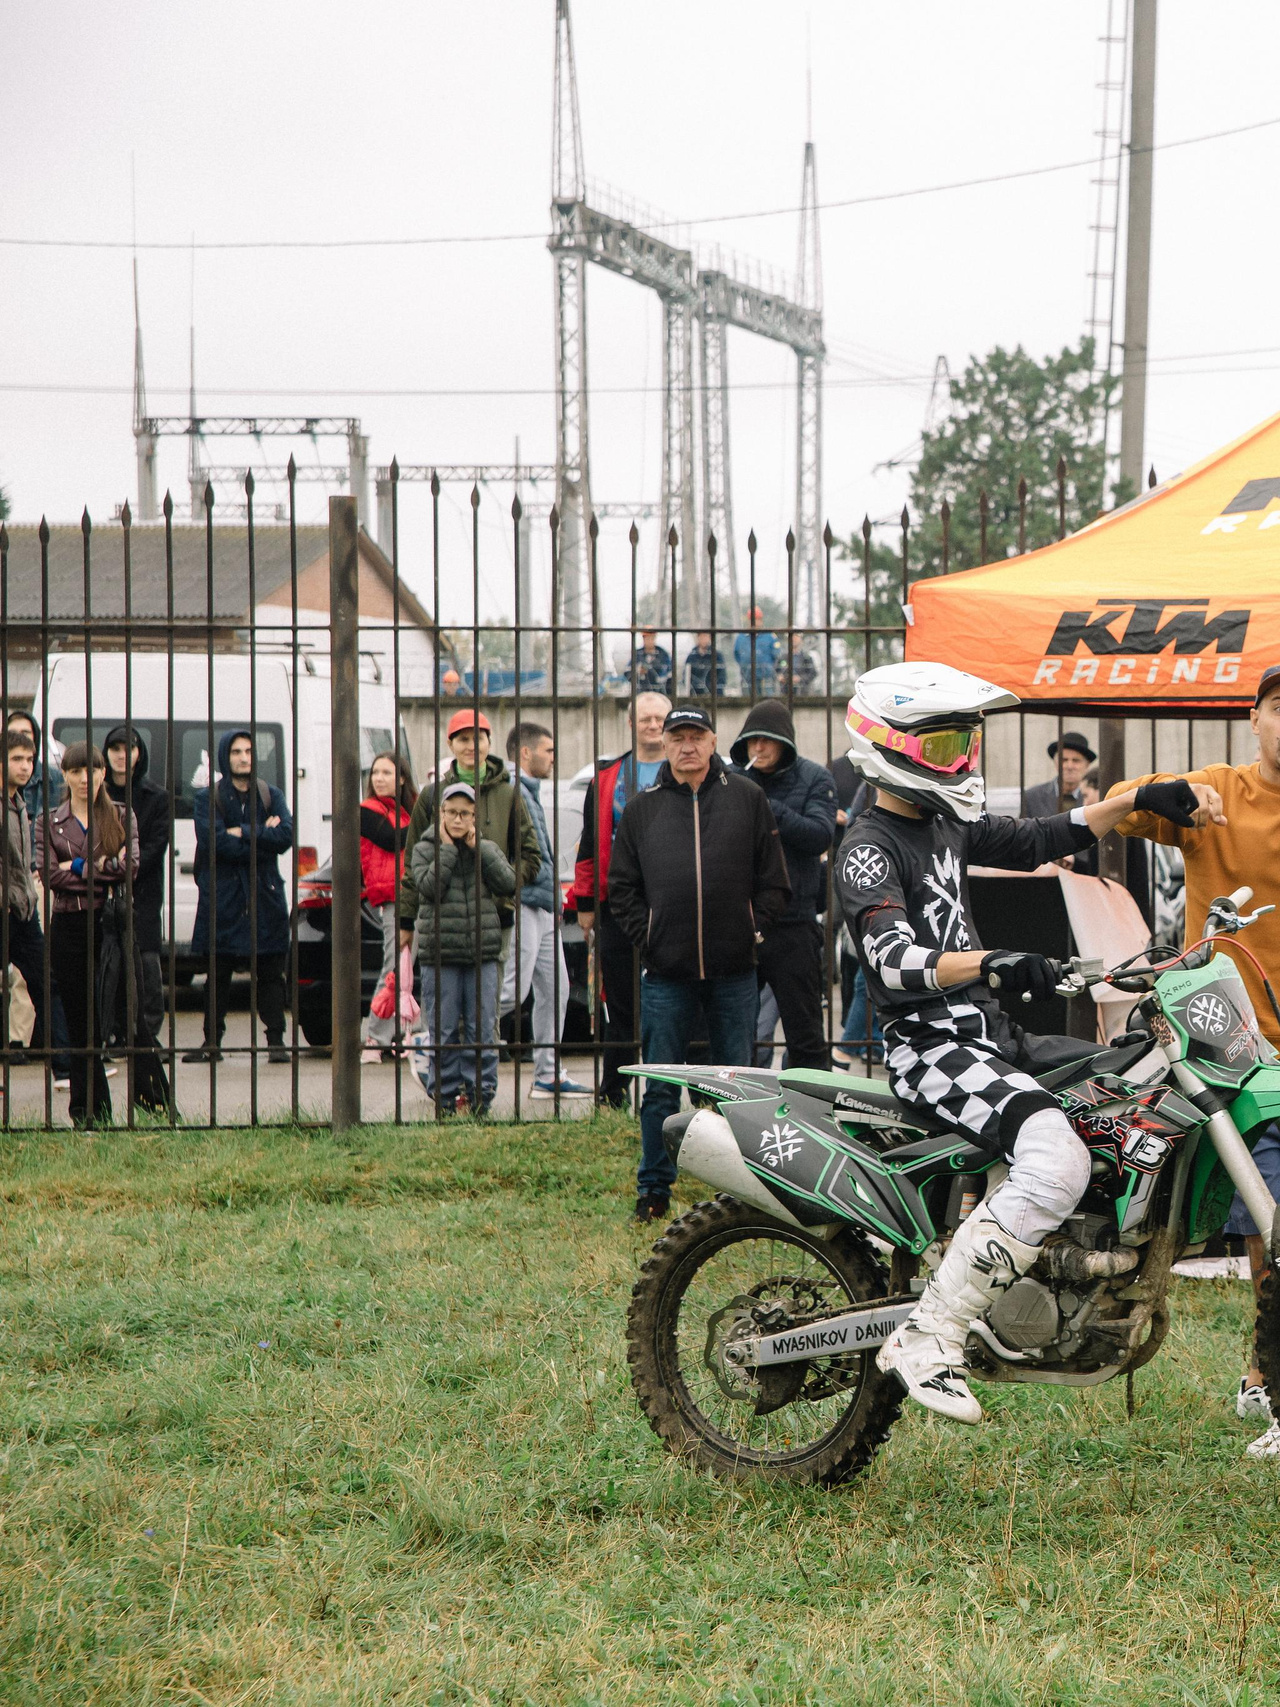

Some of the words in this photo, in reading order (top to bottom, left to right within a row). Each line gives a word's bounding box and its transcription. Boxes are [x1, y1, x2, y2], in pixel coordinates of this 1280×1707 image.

[1045, 599, 1251, 655] KTM
[835, 1091, 903, 1121] Kawasaki
[772, 1327, 848, 1355] MYASNIKOV
